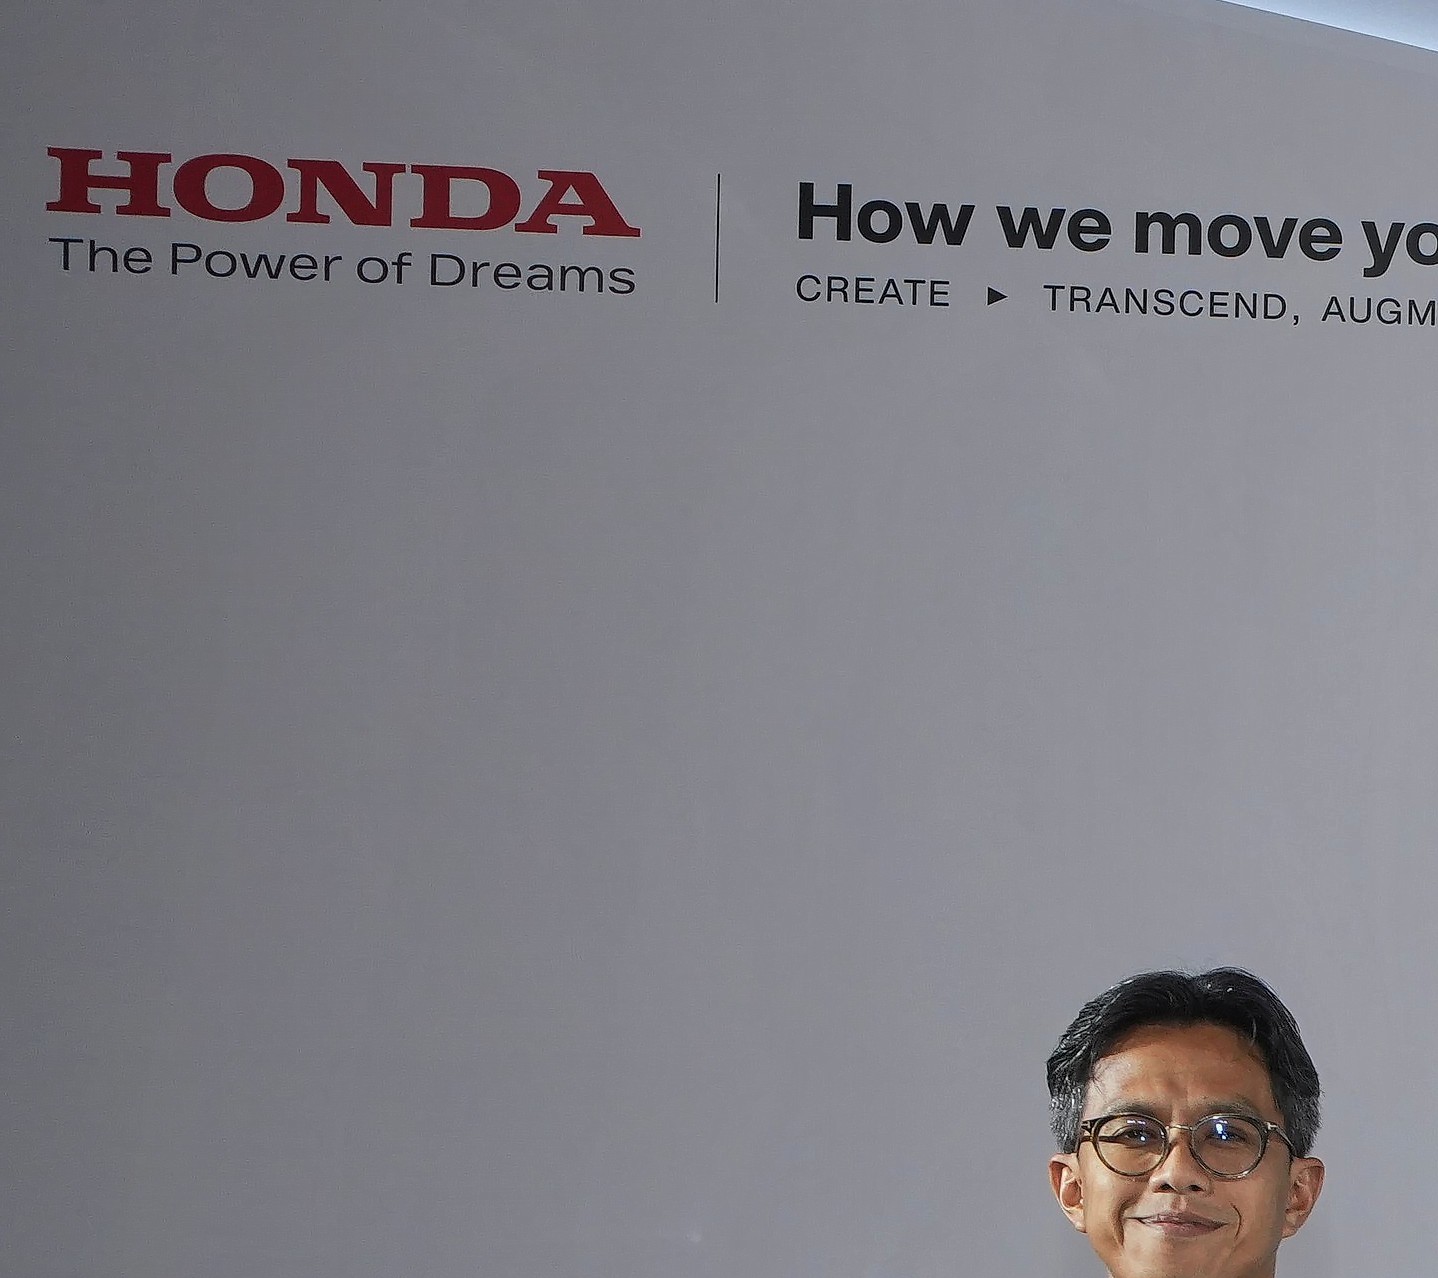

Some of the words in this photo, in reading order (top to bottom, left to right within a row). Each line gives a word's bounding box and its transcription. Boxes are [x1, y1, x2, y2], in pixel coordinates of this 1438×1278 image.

[46, 147, 641, 238] HONDA
[798, 181, 975, 247] How
[996, 205, 1112, 253] we
[1135, 211, 1343, 262] move
[48, 237, 153, 275] The
[171, 242, 343, 282] Power
[356, 251, 413, 285] of
[430, 253, 636, 295] Dreams
[796, 274, 950, 307] CREATE
[1042, 284, 1300, 326] TRANSCEND,
